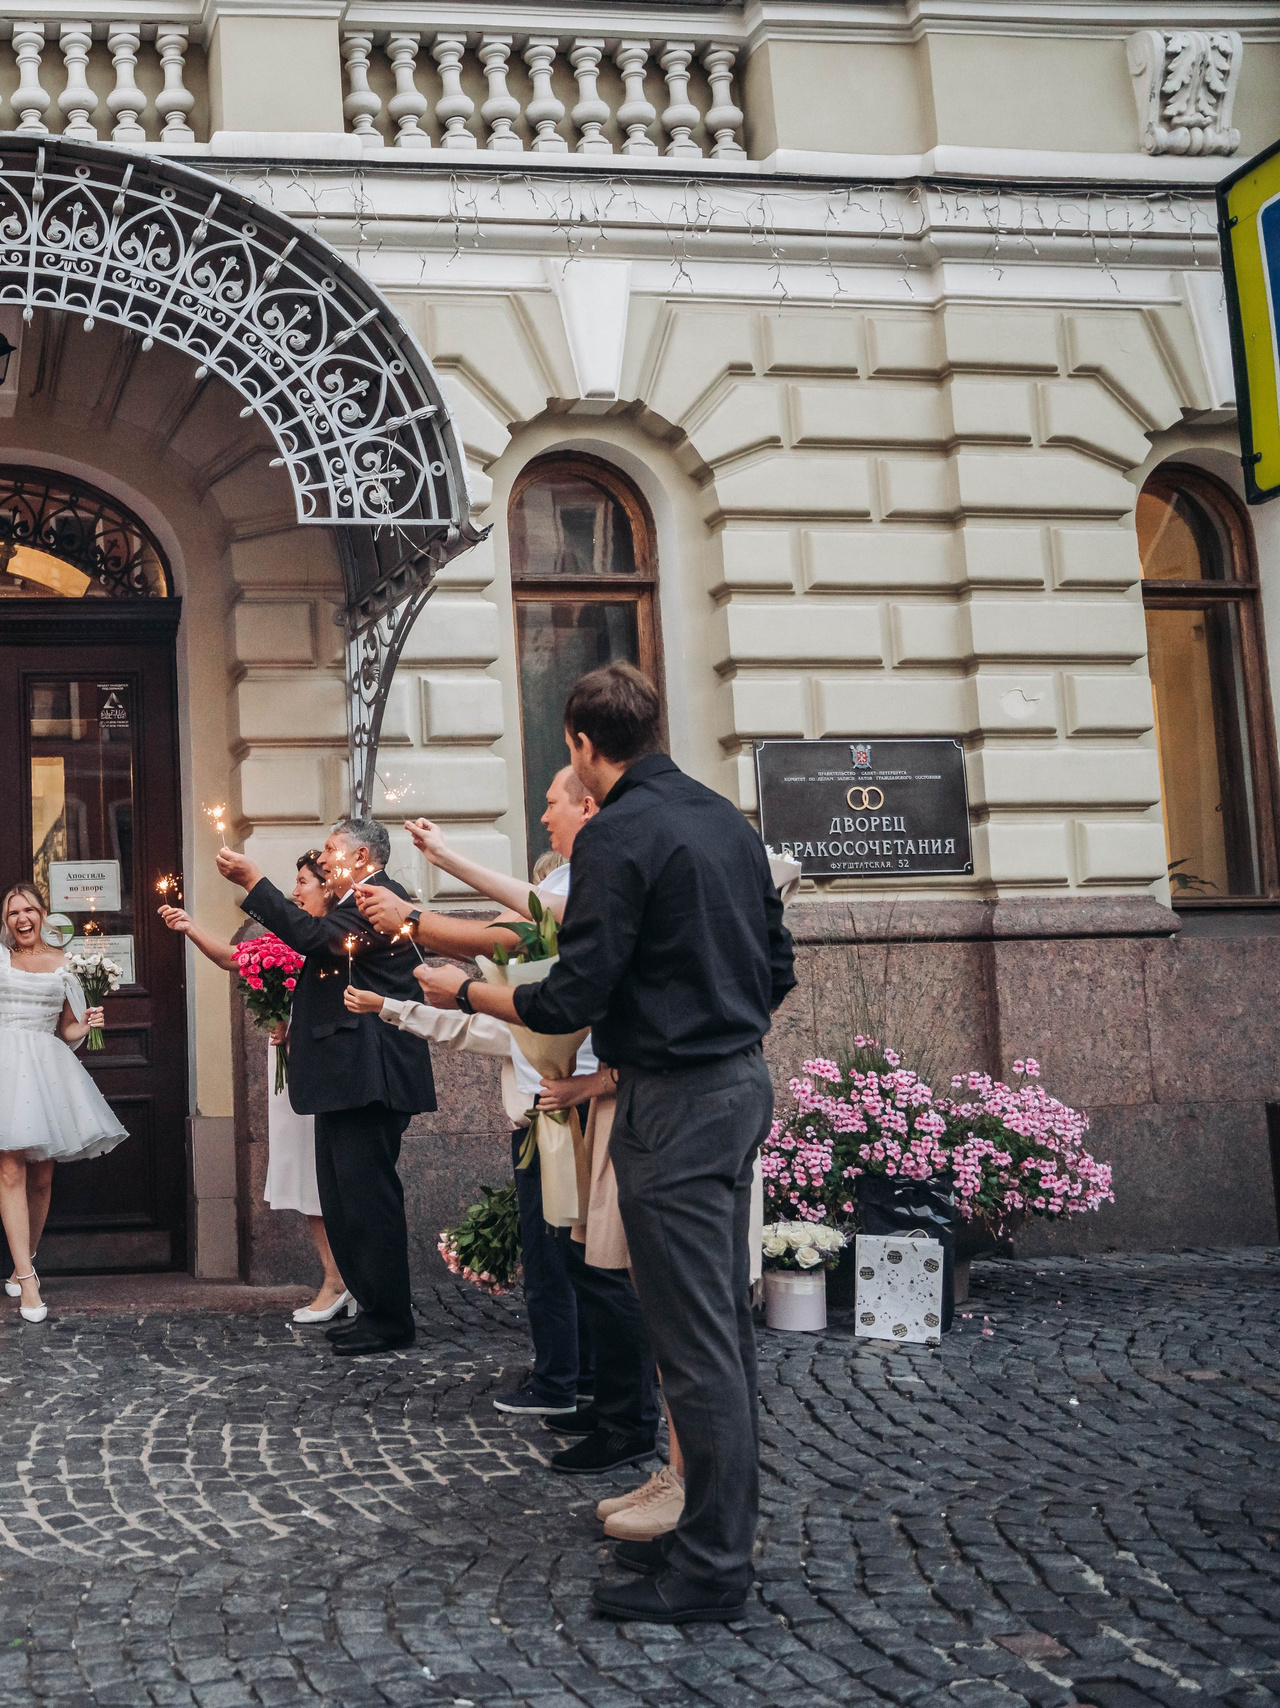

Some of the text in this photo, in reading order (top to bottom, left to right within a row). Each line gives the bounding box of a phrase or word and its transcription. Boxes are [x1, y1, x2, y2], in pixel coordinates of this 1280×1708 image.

[829, 816, 906, 835] ДВОРЕЦ
[780, 838, 956, 858] БРАКОСОЧЕТАНИЯ
[898, 860, 910, 868] 52
[66, 872, 106, 880] Апостиль
[81, 884, 104, 892] дворе
